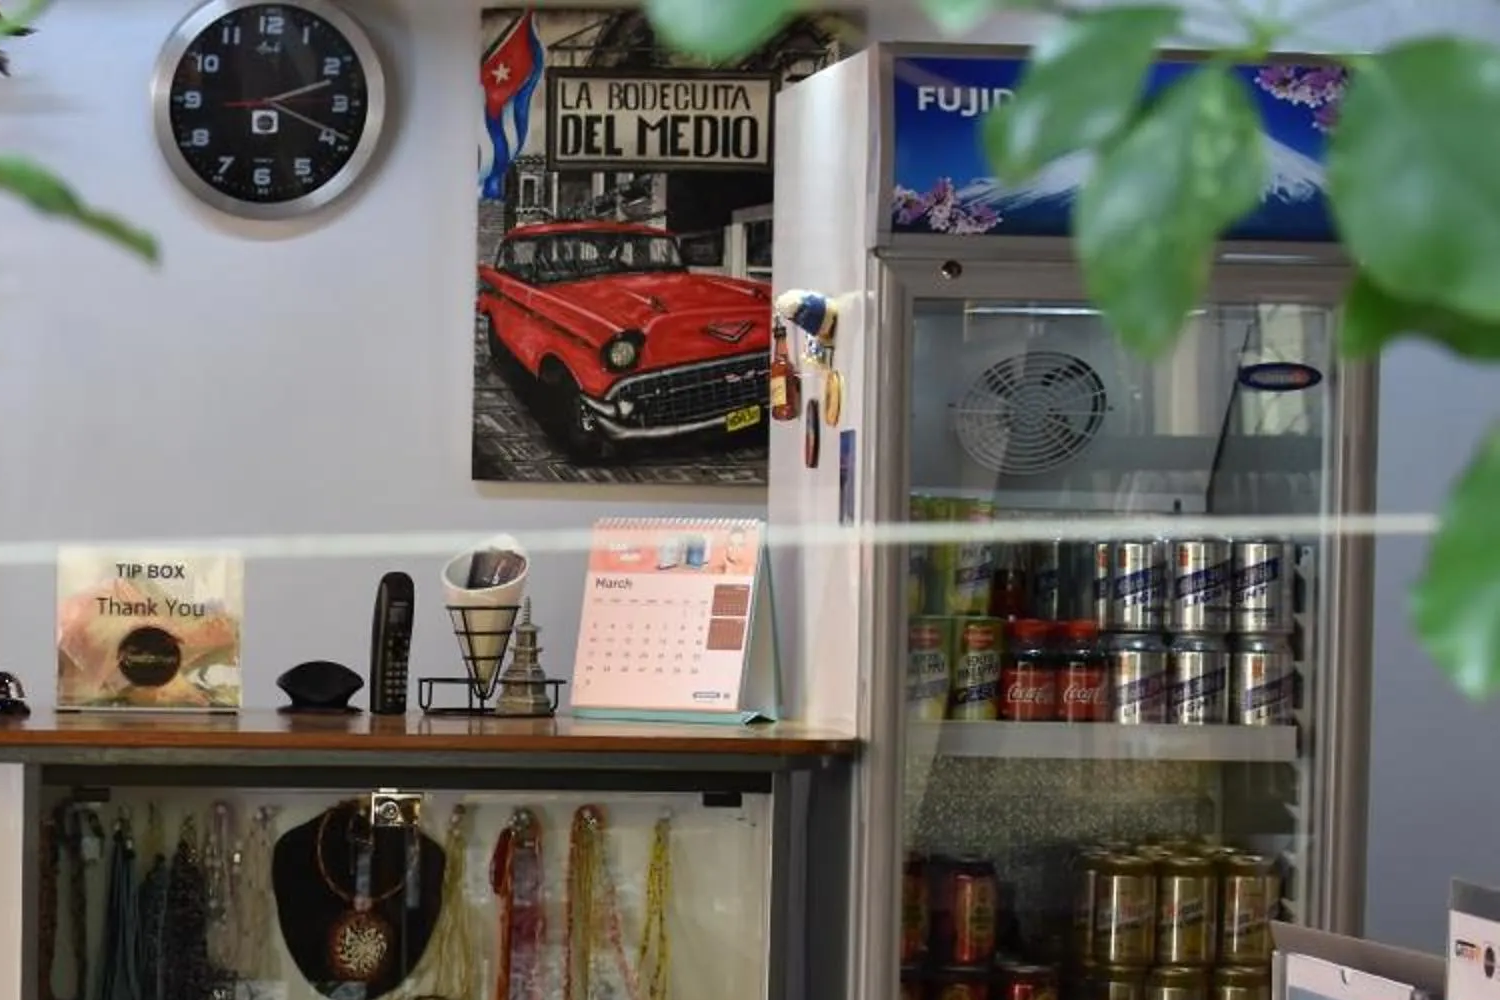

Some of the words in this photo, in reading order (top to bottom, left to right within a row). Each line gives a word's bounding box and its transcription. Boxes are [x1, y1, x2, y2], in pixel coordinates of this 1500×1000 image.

[259, 16, 285, 35] 12
[302, 26, 310, 44] 1
[222, 27, 241, 45] 11
[196, 54, 219, 73] 10
[323, 57, 341, 76] 2
[184, 91, 202, 109] 9
[332, 94, 348, 113] 3
[559, 80, 593, 111] LA
[192, 128, 210, 147] 8
[318, 127, 336, 146] 4
[559, 113, 623, 157] DEL
[636, 113, 760, 159] MEDIO
[218, 156, 235, 174] 7
[294, 158, 312, 176] 5
[253, 168, 271, 185] 6
[115, 562, 143, 580] TIP
[146, 563, 186, 580] BOX
[594, 576, 634, 591] March
[95, 596, 159, 618] Thank
[164, 598, 206, 618] You
